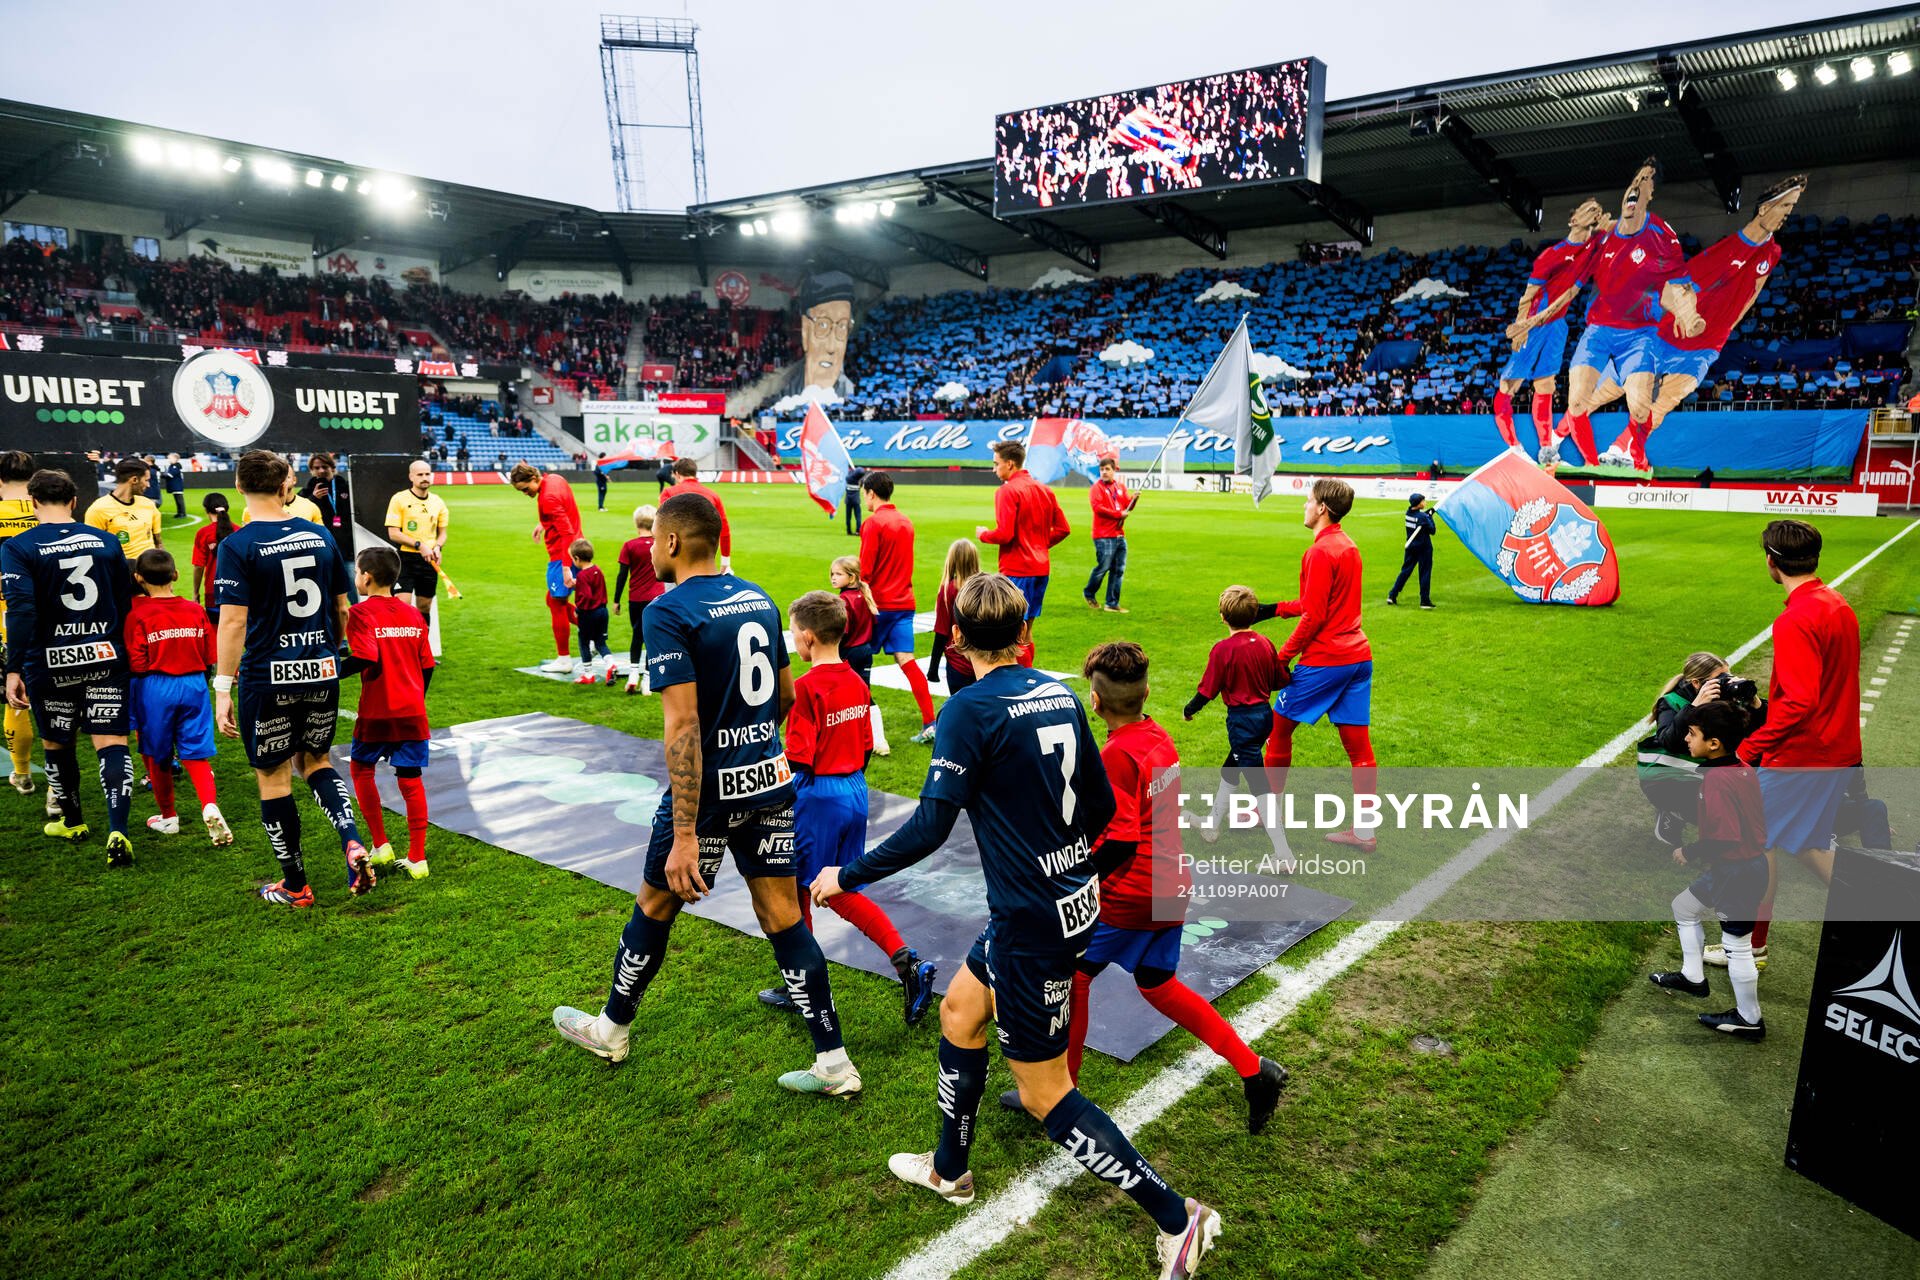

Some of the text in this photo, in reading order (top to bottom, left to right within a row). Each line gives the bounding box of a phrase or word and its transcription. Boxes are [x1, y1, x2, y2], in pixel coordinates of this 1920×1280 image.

[327, 253, 360, 275] MAX
[3, 375, 146, 406] UNIBET
[295, 388, 400, 415] UNIBET
[593, 417, 673, 443] akea
[884, 424, 972, 451] Kalle
[1301, 435, 1391, 454] ner
[1859, 472, 1908, 486] PUMA
[1627, 489, 1689, 505] granitor
[1766, 491, 1838, 506] WANS
[39, 541, 105, 556] HAMMARVIKEN
[259, 539, 326, 557] HAMMARVIKEN
[58, 555, 99, 611] 3
[281, 555, 322, 618] 5
[709, 600, 772, 619] HAMMARVIKEN
[54, 621, 108, 637] AZULAY
[280, 629, 326, 648] STYFFE
[50, 645, 96, 667] BESAB
[737, 621, 775, 707] 6
[274, 661, 321, 682] BESAB
[86, 703, 122, 718] NTEX
[1007, 697, 1077, 719] HAMMARVIKEN
[51, 715, 74, 730] NTE
[256, 732, 292, 757] NTEX
[45, 763, 68, 800] MIKE
[721, 763, 777, 797] BESAB
[1036, 722, 1077, 827] 7
[262, 821, 292, 860] MIKE
[766, 857, 791, 865] umbro
[614, 947, 651, 997] MIKE
[780, 968, 815, 1019] MIKE
[820, 1009, 834, 1033] umbro
[1824, 1002, 1920, 1064] SELEC
[958, 1114, 970, 1146] umbro
[1064, 1126, 1143, 1190] MIKE
[1135, 1159, 1168, 1191] umbro
